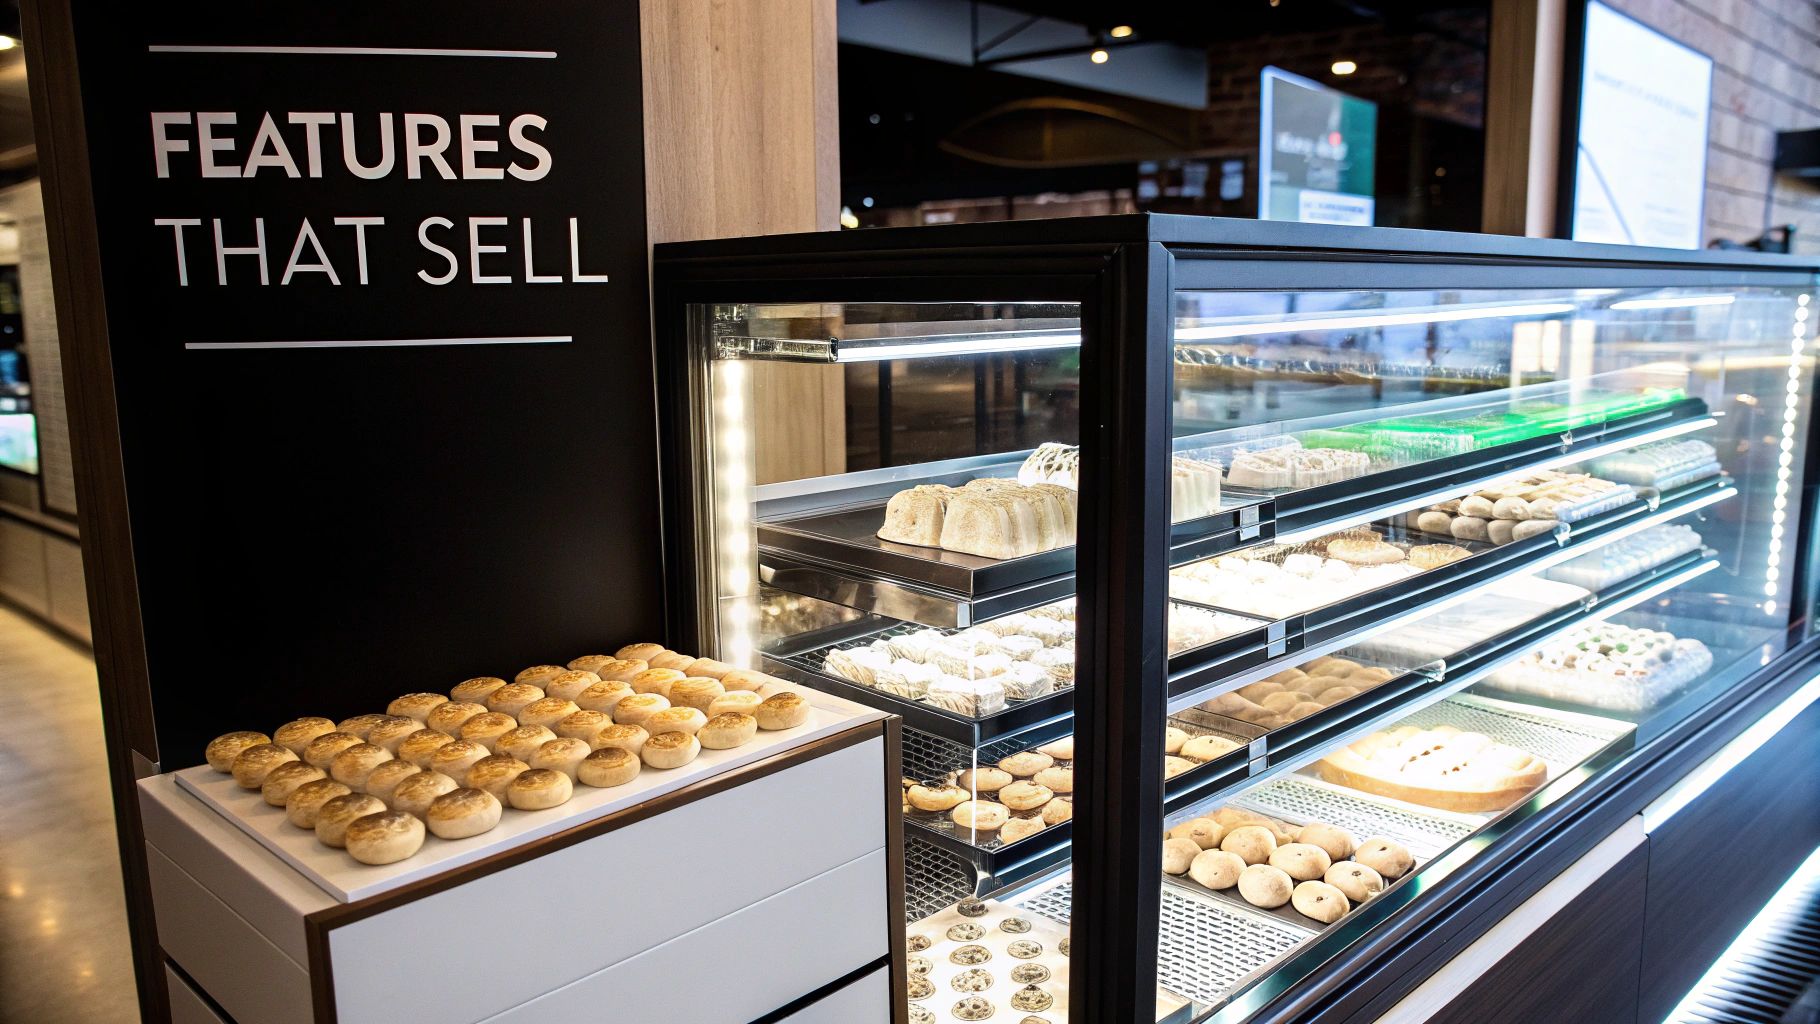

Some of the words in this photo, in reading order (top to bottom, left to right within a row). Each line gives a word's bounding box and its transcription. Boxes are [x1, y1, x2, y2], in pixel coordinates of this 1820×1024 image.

[151, 111, 553, 182] FEATURES
[154, 216, 385, 287] THAT
[417, 216, 609, 286] SELL
